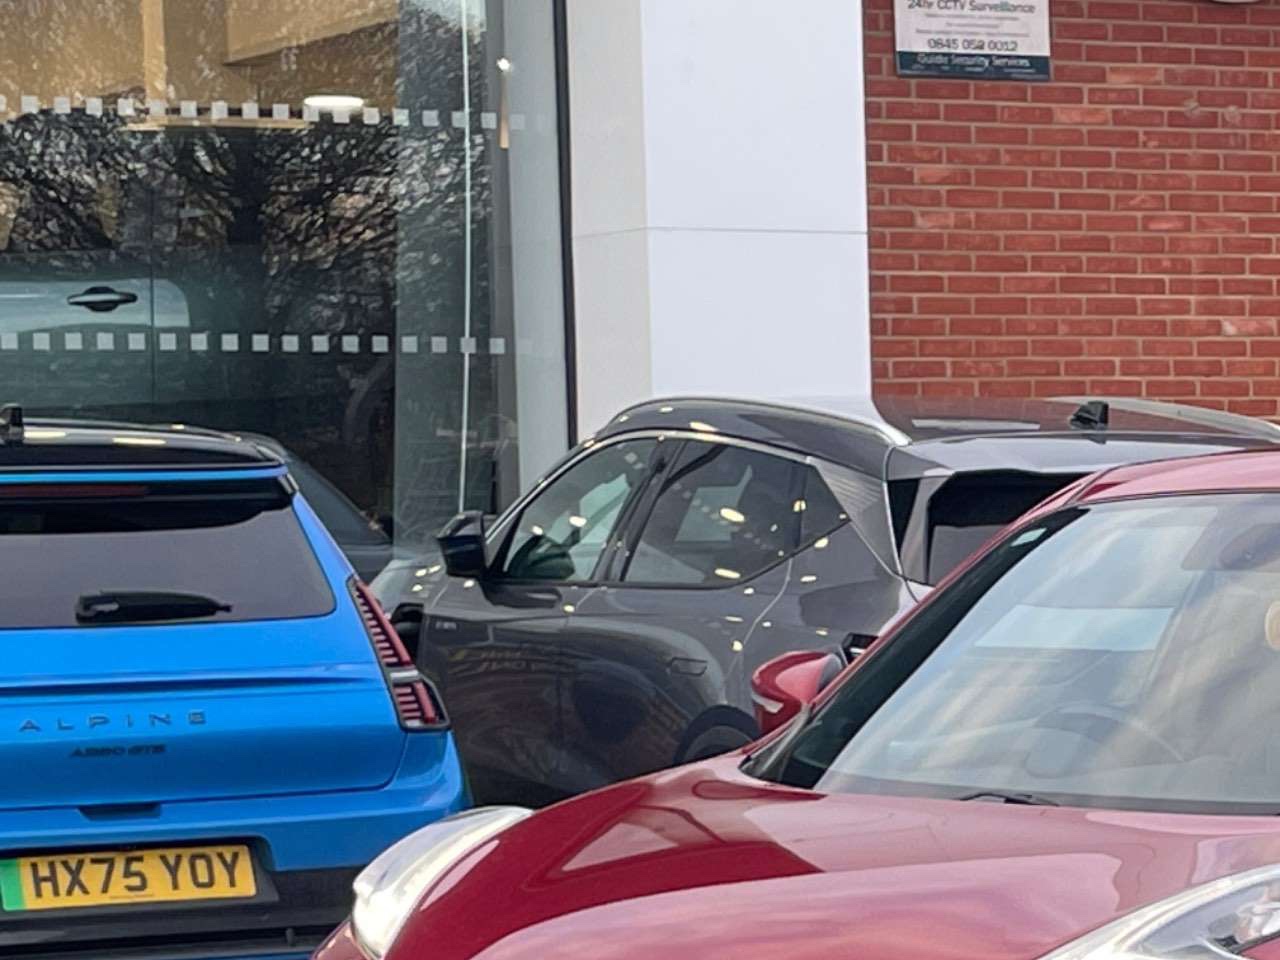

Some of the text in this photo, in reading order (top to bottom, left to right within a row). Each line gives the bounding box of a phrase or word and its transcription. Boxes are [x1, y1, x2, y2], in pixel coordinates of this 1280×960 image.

[937, 0, 965, 10] CCTV
[967, 0, 1036, 13] Surveillance
[19, 711, 206, 732] ALPINE
[29, 851, 240, 898] HX75 YOY
